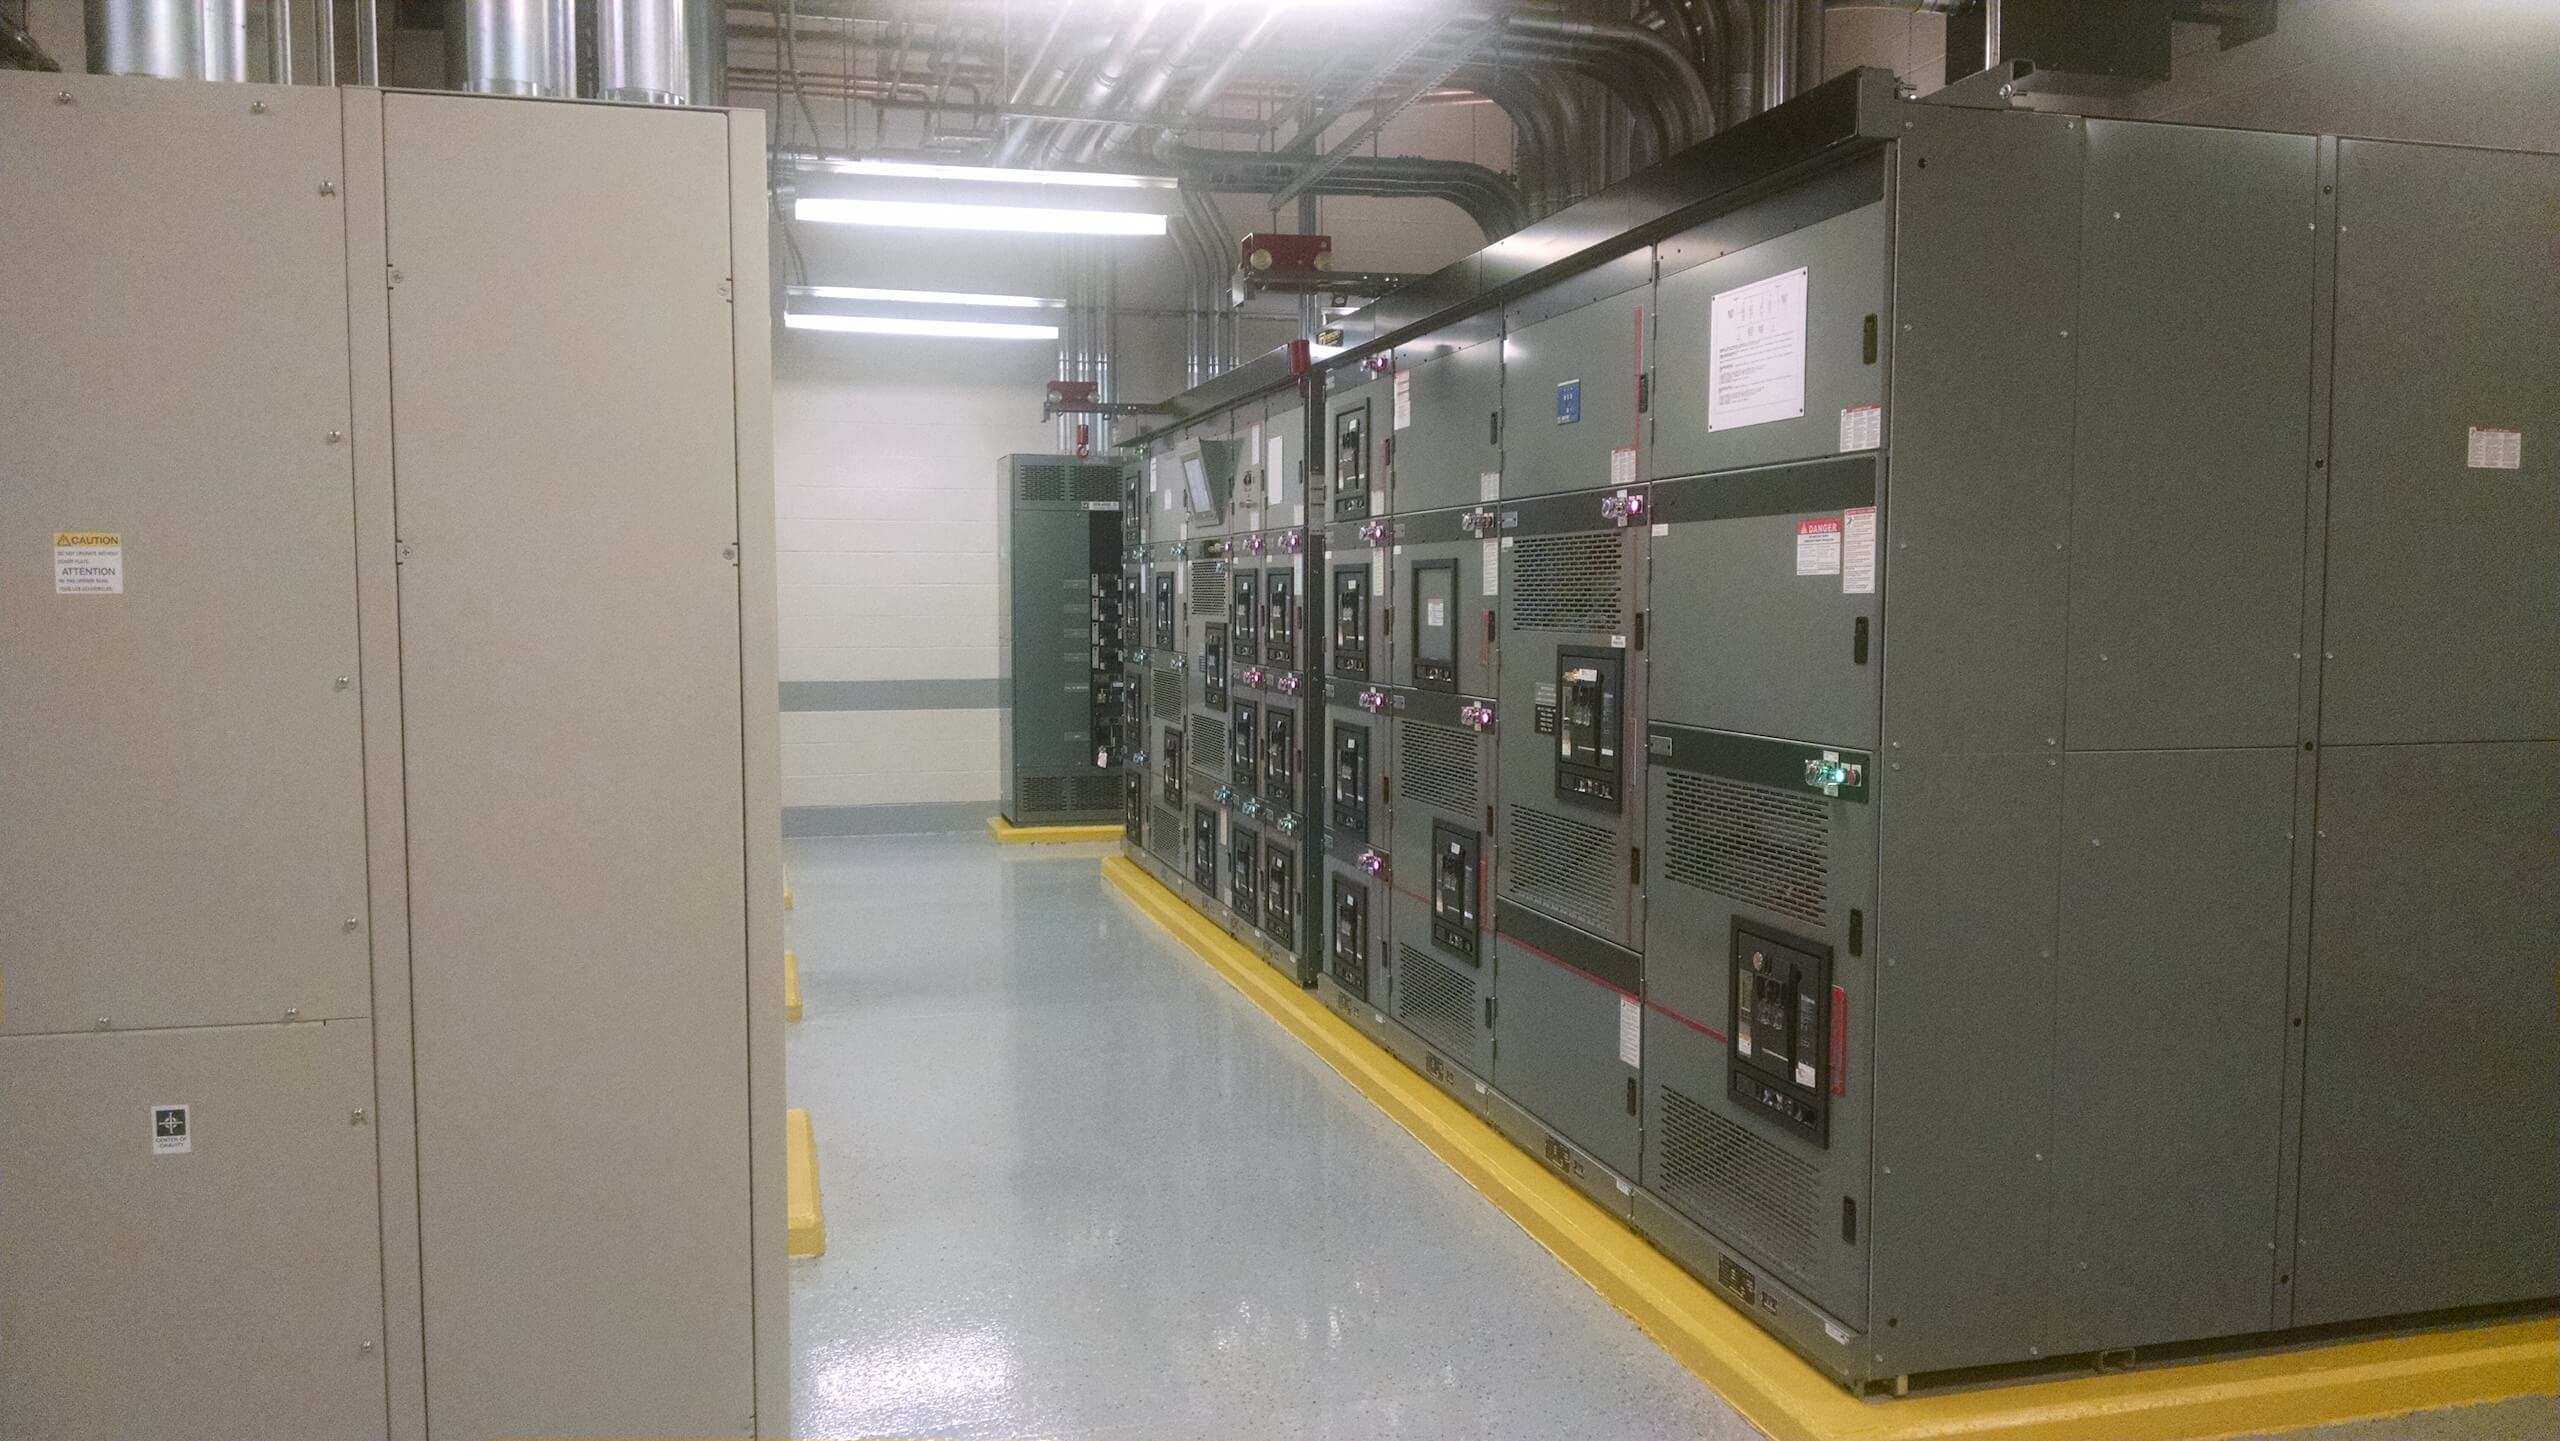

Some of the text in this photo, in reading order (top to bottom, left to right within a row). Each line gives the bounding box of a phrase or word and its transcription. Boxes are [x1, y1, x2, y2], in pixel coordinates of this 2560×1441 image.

[1808, 523, 1838, 533] DANGER
[71, 536, 119, 545] CAUTION
[62, 567, 116, 576] ATTENTION
